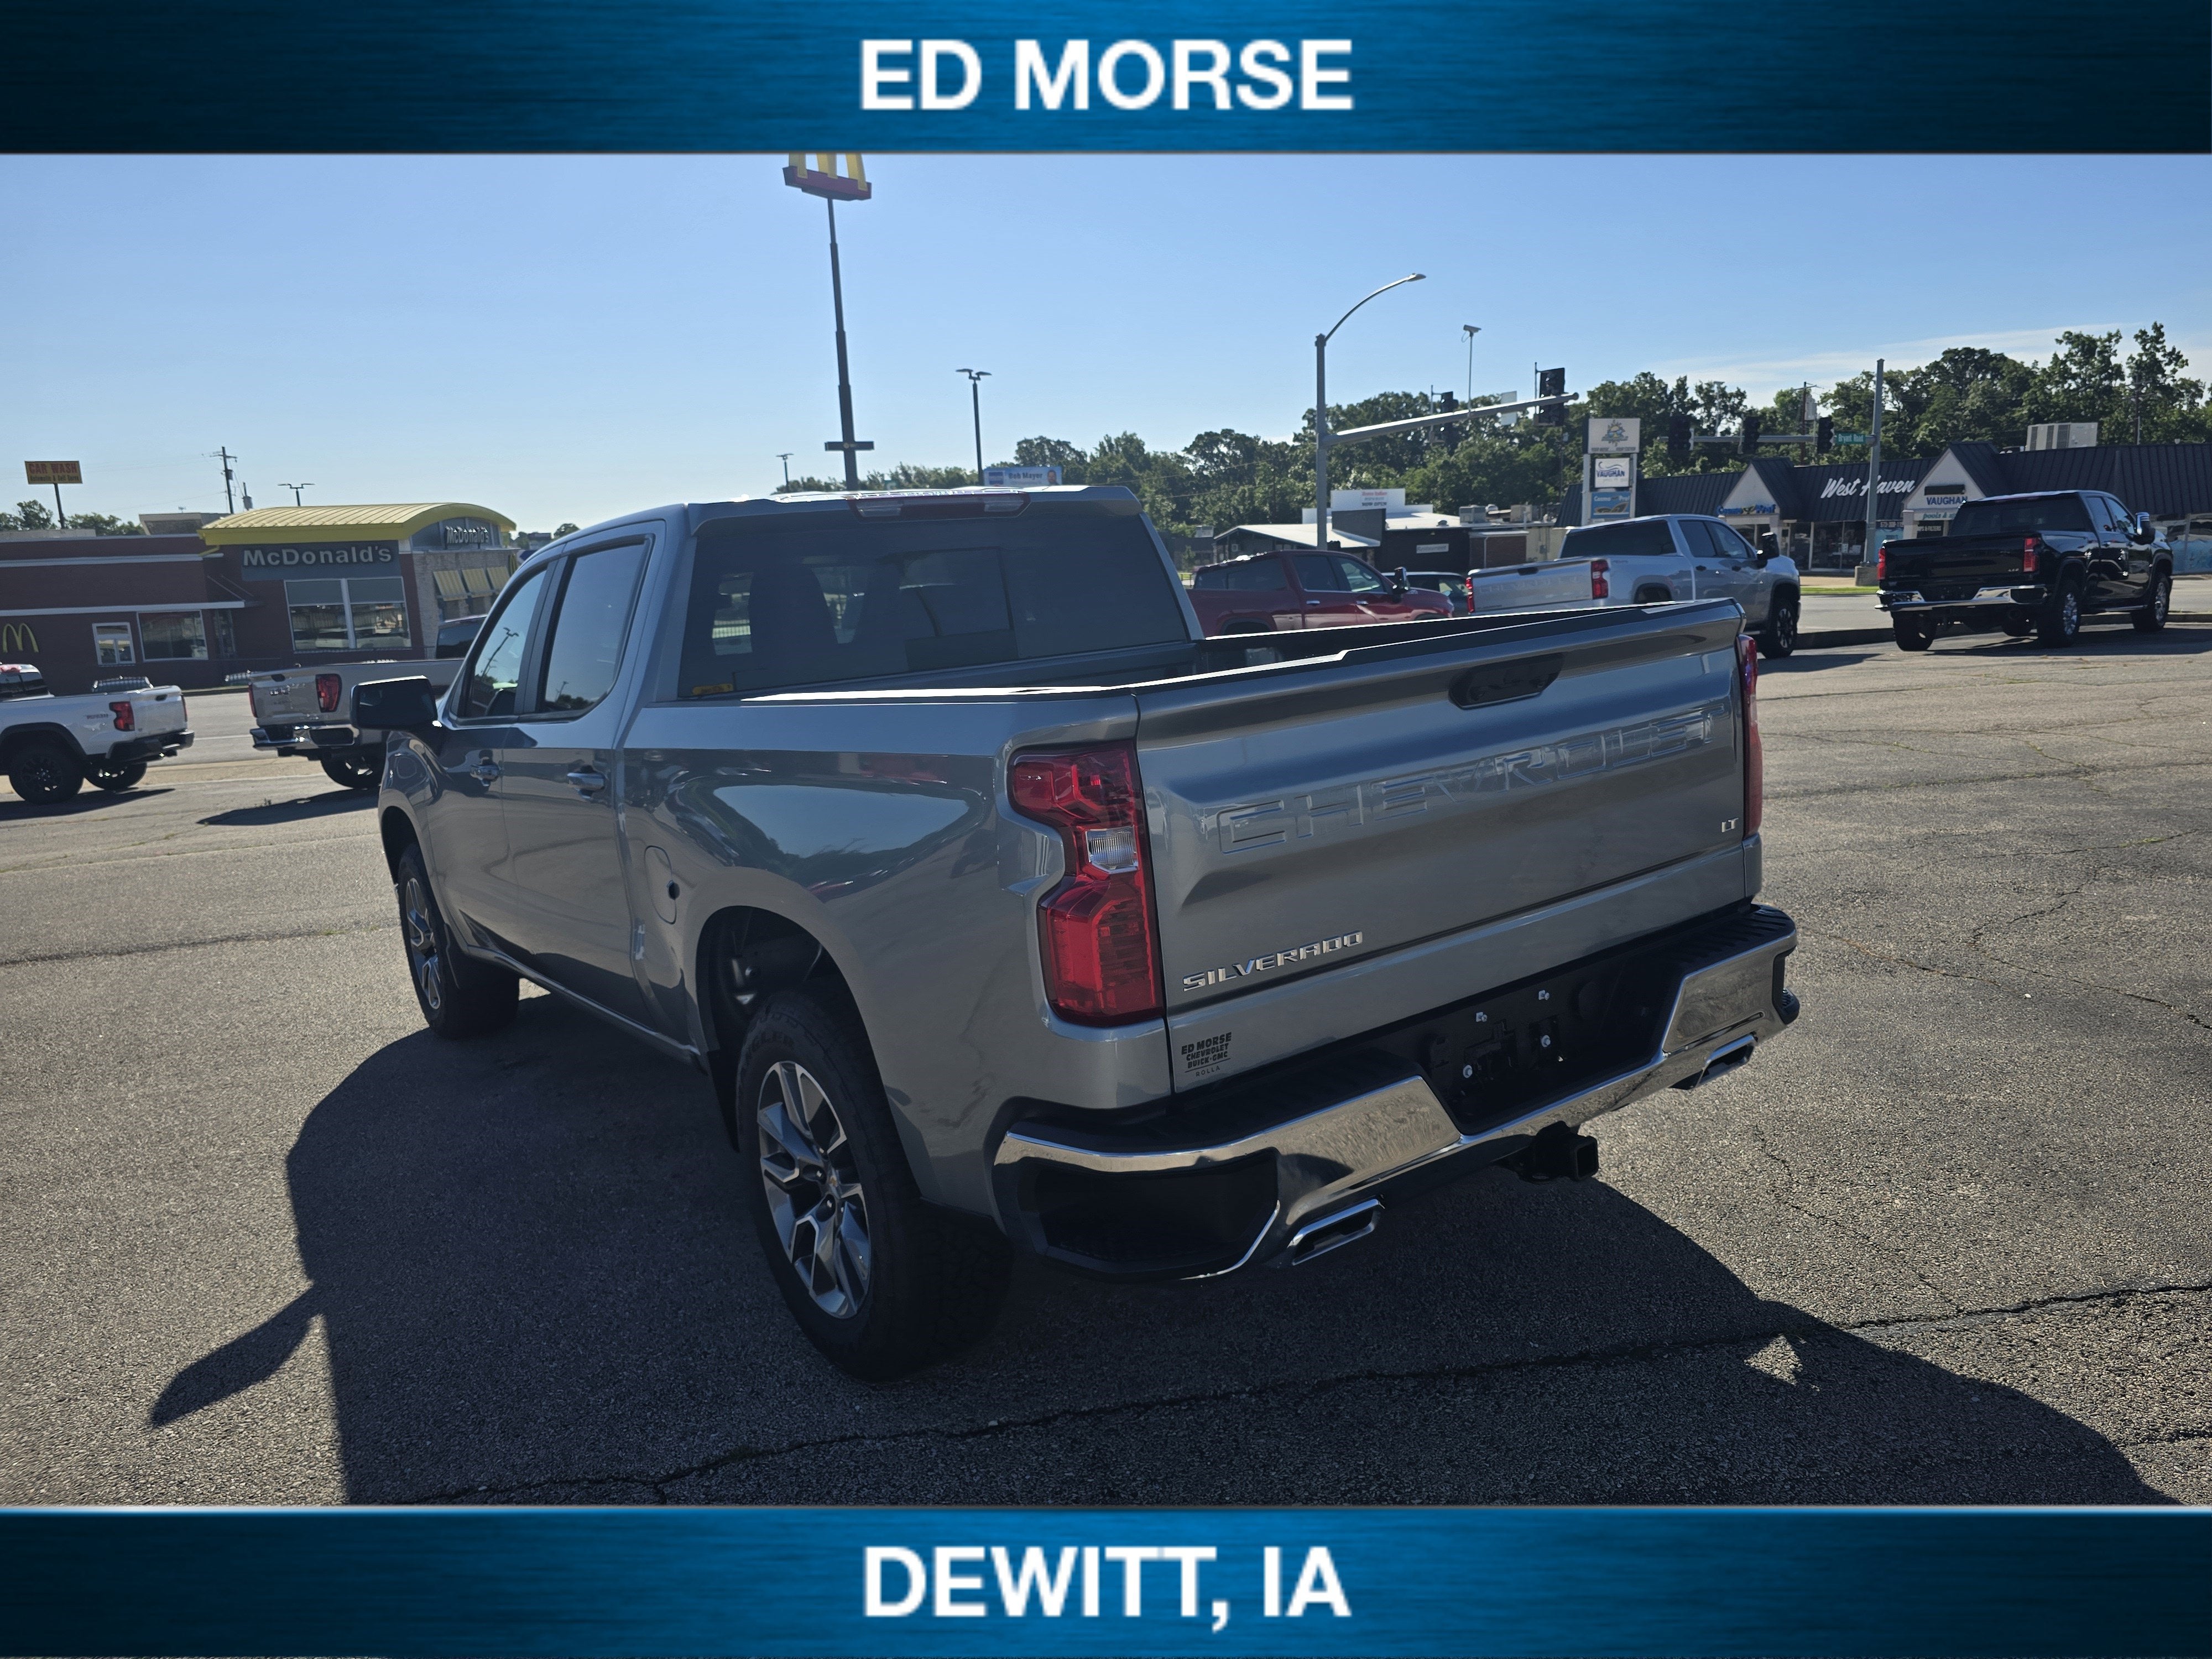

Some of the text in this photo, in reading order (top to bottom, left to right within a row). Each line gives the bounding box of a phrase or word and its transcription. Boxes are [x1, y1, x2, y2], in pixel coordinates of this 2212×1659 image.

[29, 463, 77, 473] CAR WASH
[1597, 469, 1625, 478] VAUGHAN
[1820, 477, 1861, 498] West
[446, 526, 489, 544] McDonald's
[243, 545, 392, 566] McDonald's
[1218, 703, 1725, 854] CHEVROLET
[1721, 817, 1739, 833] LT
[1182, 930, 1364, 992] SILVERADO
[1181, 1032, 1232, 1055] ED MORSE
[1186, 1043, 1229, 1061] CHEVROLET
[1196, 1066, 1220, 1077] ROLLA
